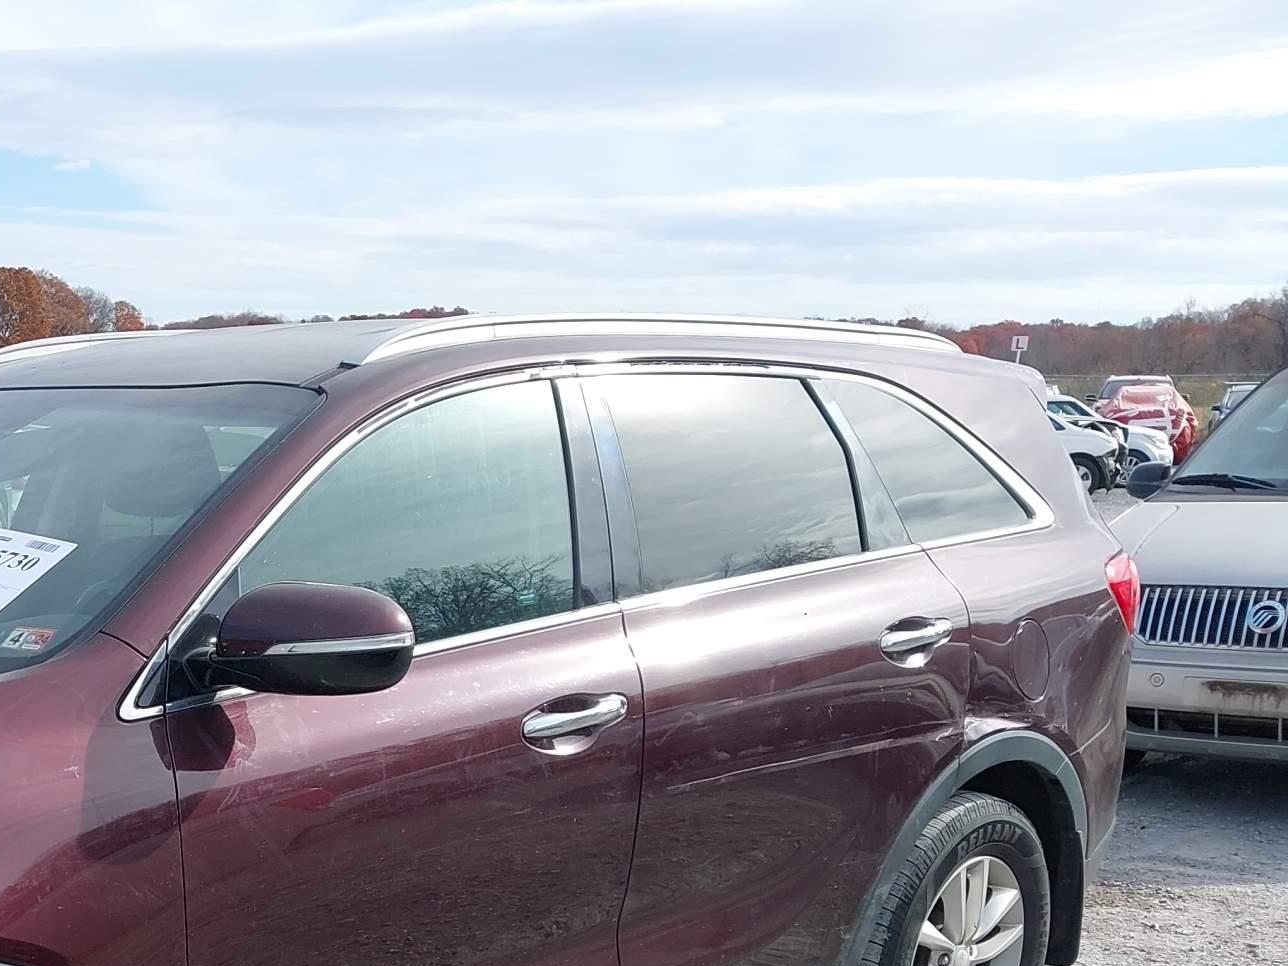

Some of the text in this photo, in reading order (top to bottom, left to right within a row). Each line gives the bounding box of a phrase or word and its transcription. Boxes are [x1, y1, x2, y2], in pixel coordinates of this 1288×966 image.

[1016, 337, 1025, 350] L
[9, 632, 25, 645] 4
[957, 823, 1022, 863] RELIANT
